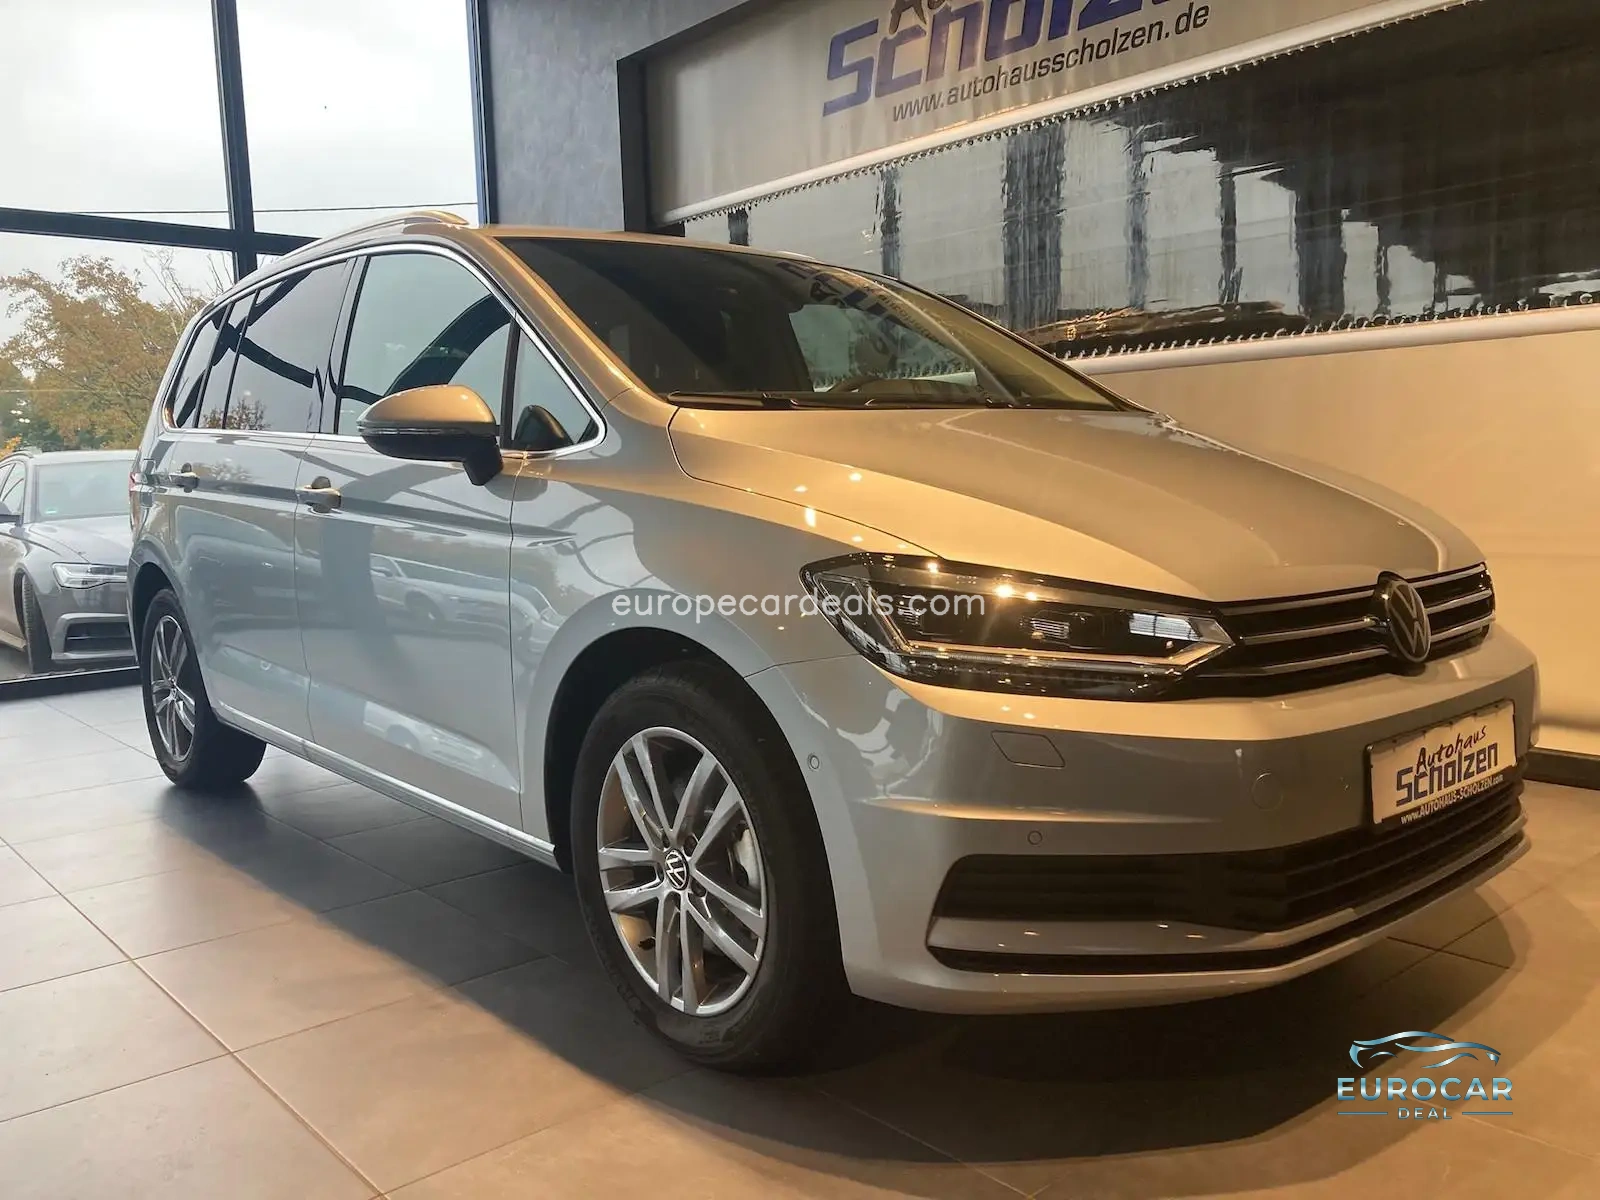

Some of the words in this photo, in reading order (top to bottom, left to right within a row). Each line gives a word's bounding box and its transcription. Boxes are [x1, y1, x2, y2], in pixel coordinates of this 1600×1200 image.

[823, 0, 1170, 117] Scho
[892, 3, 1209, 122] www.autohausscholzen.de
[1396, 742, 1498, 807] Scholzen
[1416, 725, 1487, 774] Autohaus
